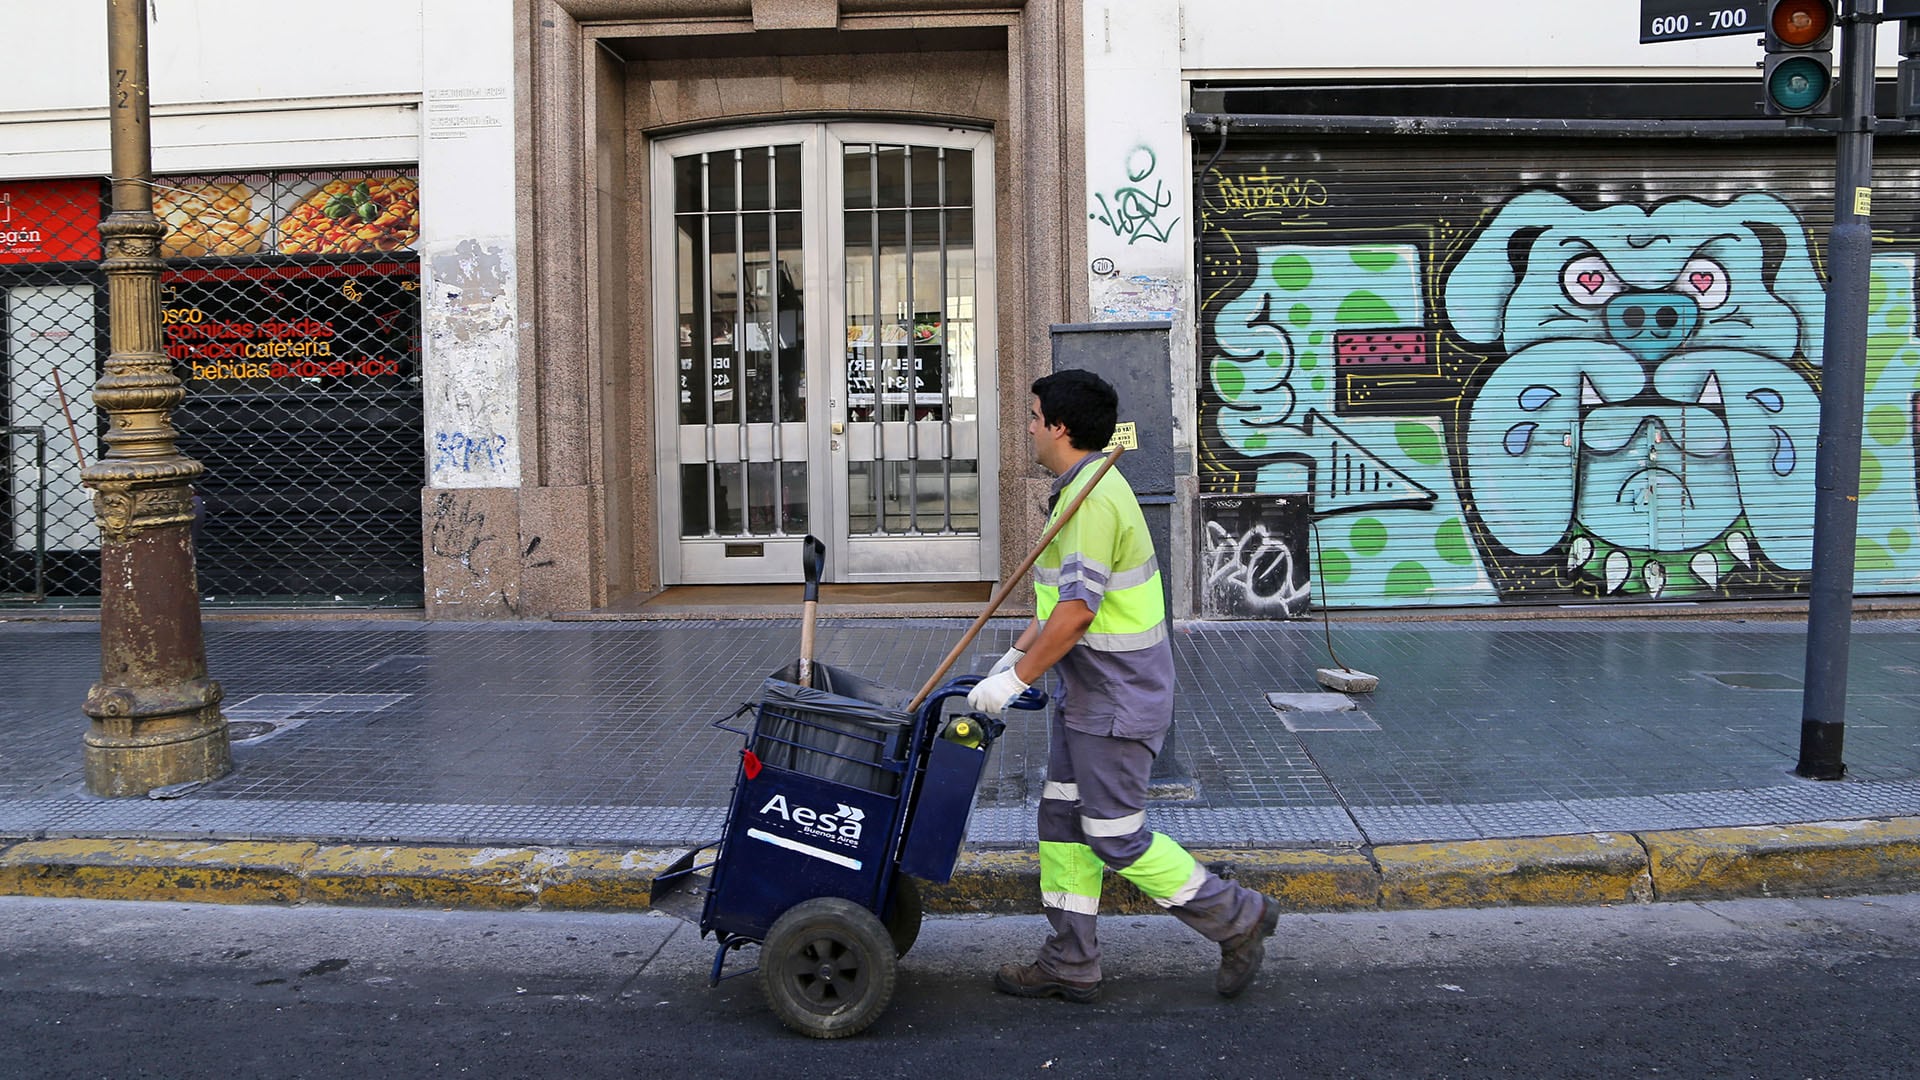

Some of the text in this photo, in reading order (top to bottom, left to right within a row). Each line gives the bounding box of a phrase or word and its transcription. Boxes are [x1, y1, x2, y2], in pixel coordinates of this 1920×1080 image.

[1651, 15, 1689, 36] 600
[1709, 8, 1747, 30] 700
[0, 227, 41, 246] egón
[161, 308, 203, 324] osco
[167, 316, 334, 342] comidas rápidas
[245, 337, 332, 358] cafetería
[192, 359, 270, 380] bebidas
[760, 794, 863, 840] Aesa
[803, 826, 859, 846] Buenos Aires
